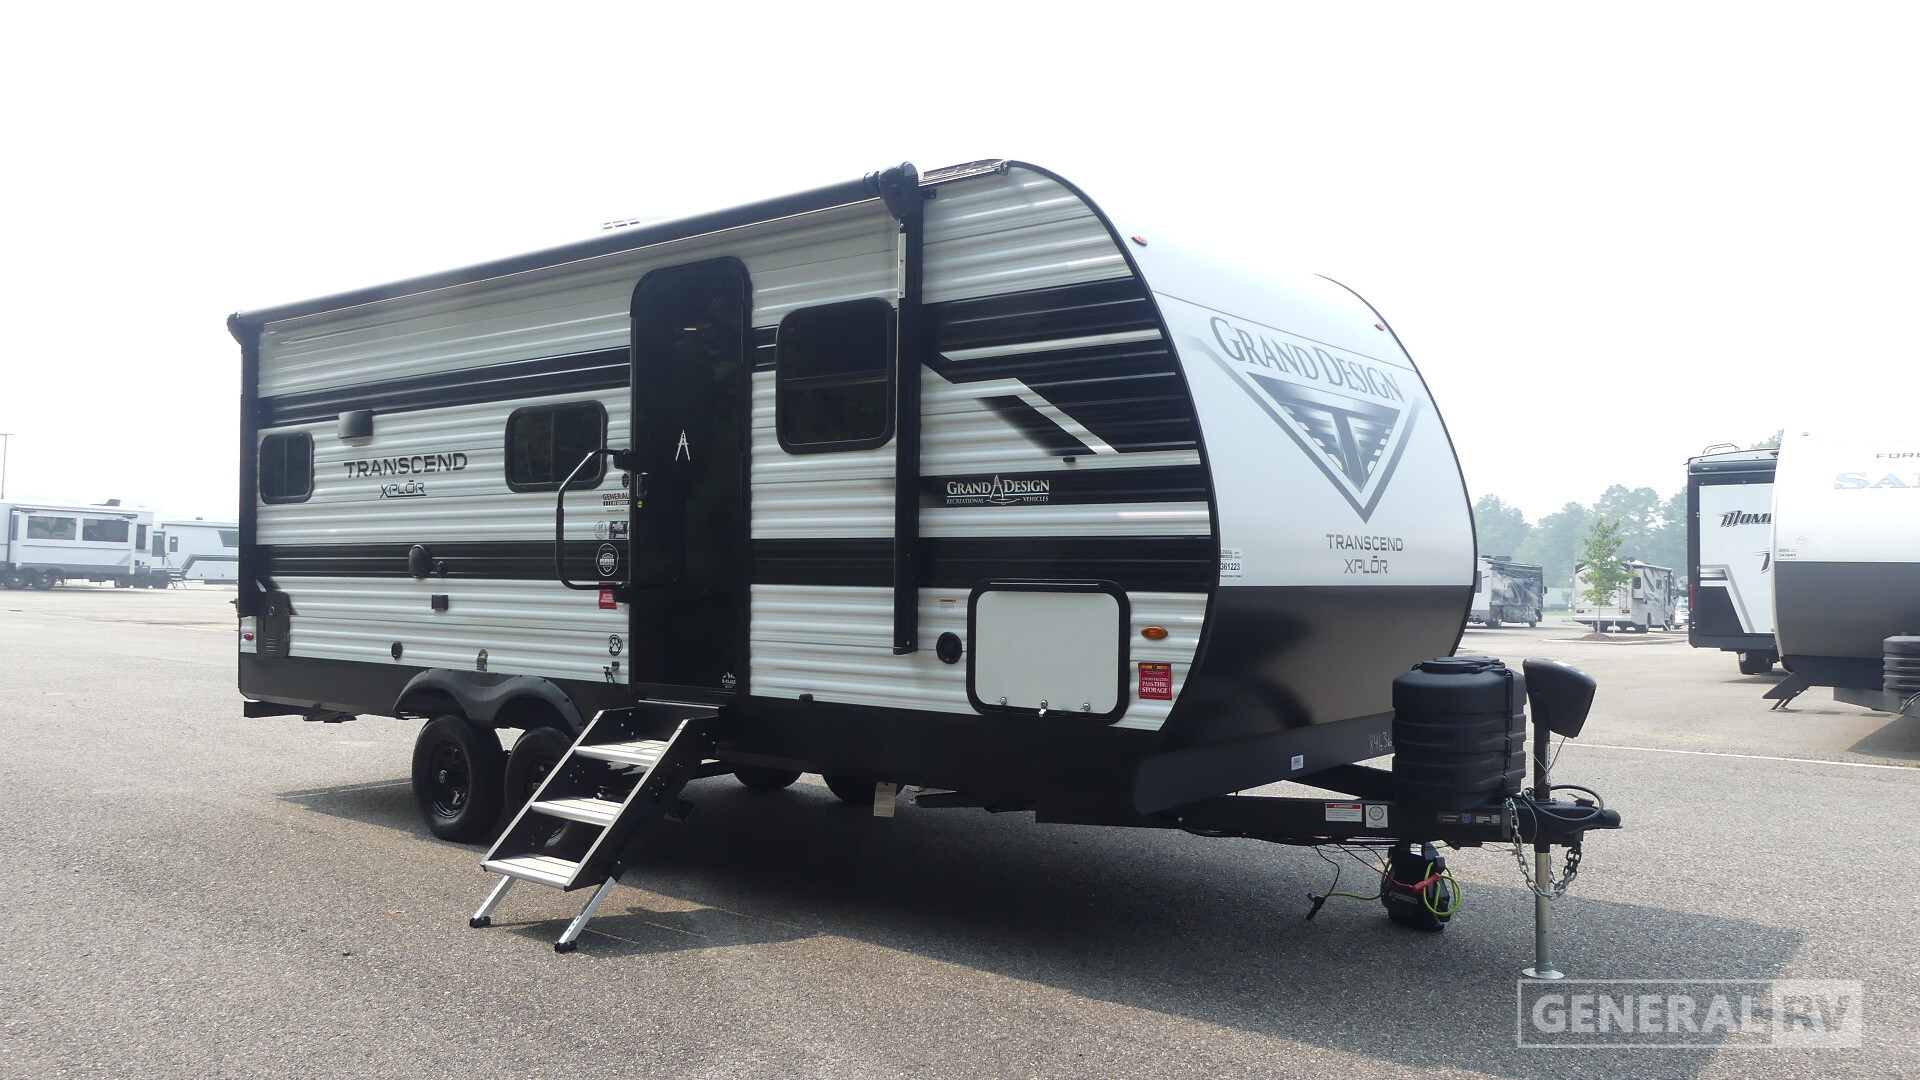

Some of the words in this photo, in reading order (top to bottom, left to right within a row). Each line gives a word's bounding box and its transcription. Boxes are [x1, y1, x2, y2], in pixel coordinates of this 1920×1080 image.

[1210, 316, 1319, 381] GRAND
[1312, 347, 1405, 403] DESIGN
[343, 452, 468, 478] TRANSCEND
[946, 481, 992, 495] GRAND
[1002, 479, 1050, 493] DESIGN
[1326, 534, 1404, 552] TRANSCEND
